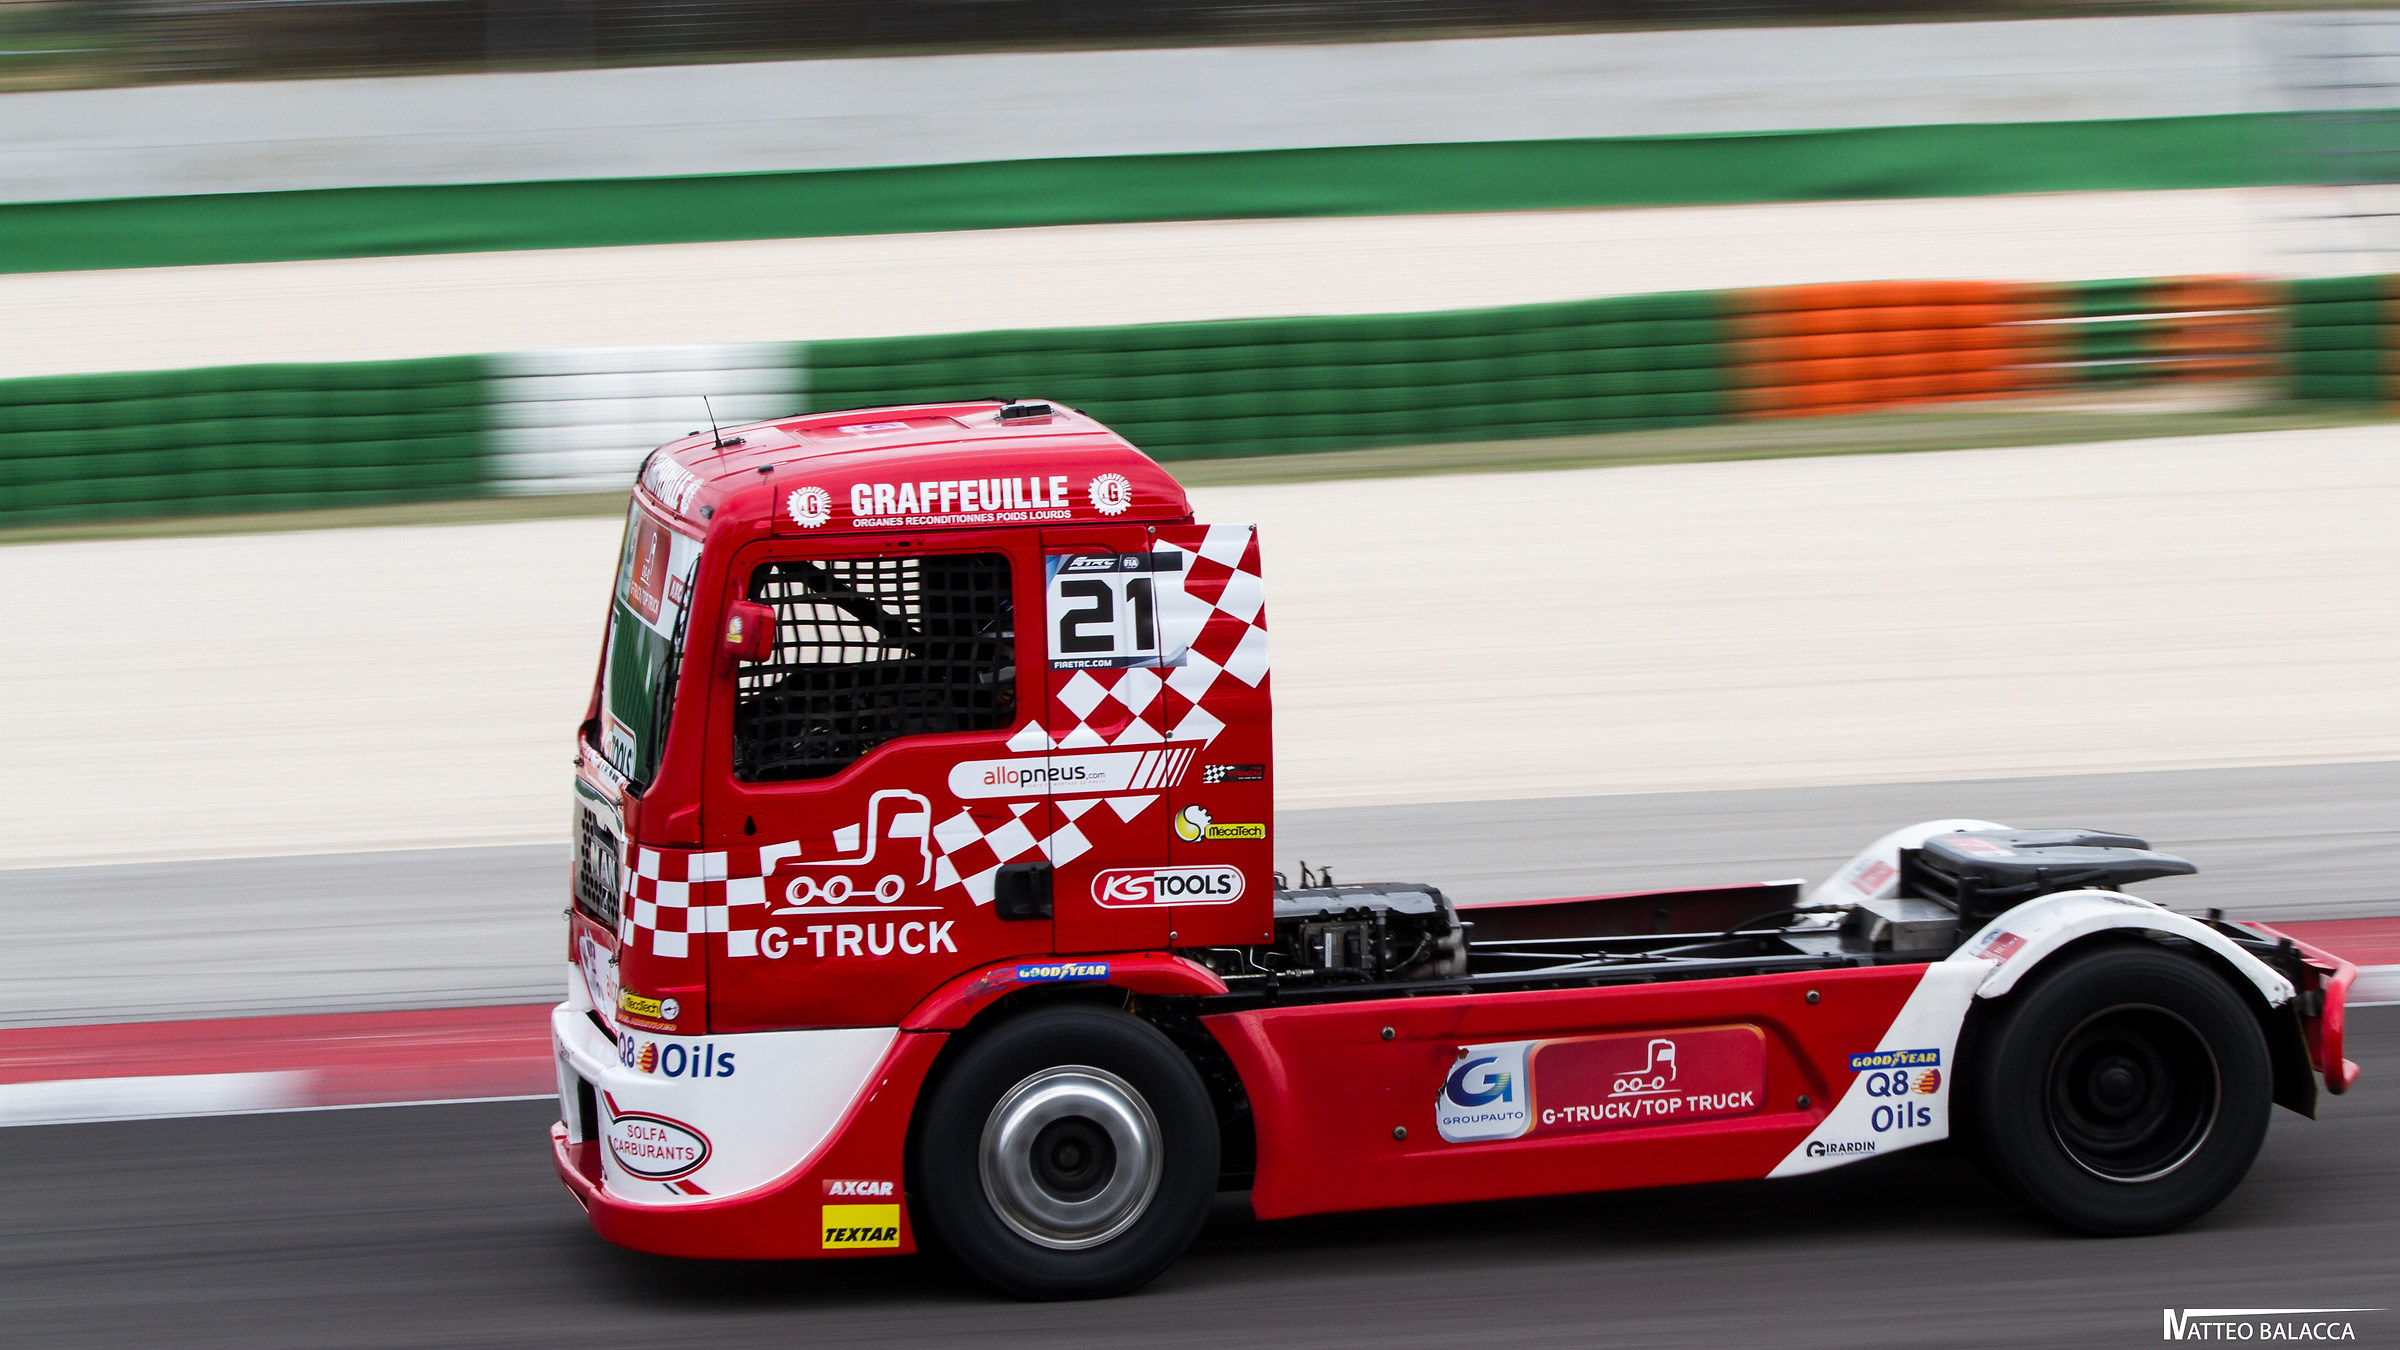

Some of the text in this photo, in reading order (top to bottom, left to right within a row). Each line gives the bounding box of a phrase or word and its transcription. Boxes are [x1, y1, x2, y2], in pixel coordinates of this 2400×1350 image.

[850, 476, 1070, 516] GRAFFEUILLE
[852, 510, 1072, 528] ORGANES RECONDITIONNES POIDS LOURDS
[1060, 578, 1155, 653] 21
[983, 766, 1106, 788] allopneus.com
[591, 841, 617, 892] MAN
[1154, 874, 1232, 896] TOOLS
[760, 921, 958, 959] G-TRUCK
[619, 1032, 736, 1078] Q8 Oils
[1852, 1051, 1938, 1067] GOODYEAR
[1866, 1070, 1909, 1097] Q8
[1443, 1110, 1524, 1125] GROUPAUTO
[1542, 1091, 1755, 1124] G-TRUCK/TOP TRUCK
[1871, 1101, 1932, 1132] Oils
[627, 1124, 667, 1142] SOLFA
[613, 1137, 695, 1161] CARBURANTS
[1806, 1141, 1876, 1157] GIRARDIN
[828, 1181, 894, 1196] AXCAR
[825, 1227, 898, 1243] TEXTAR
